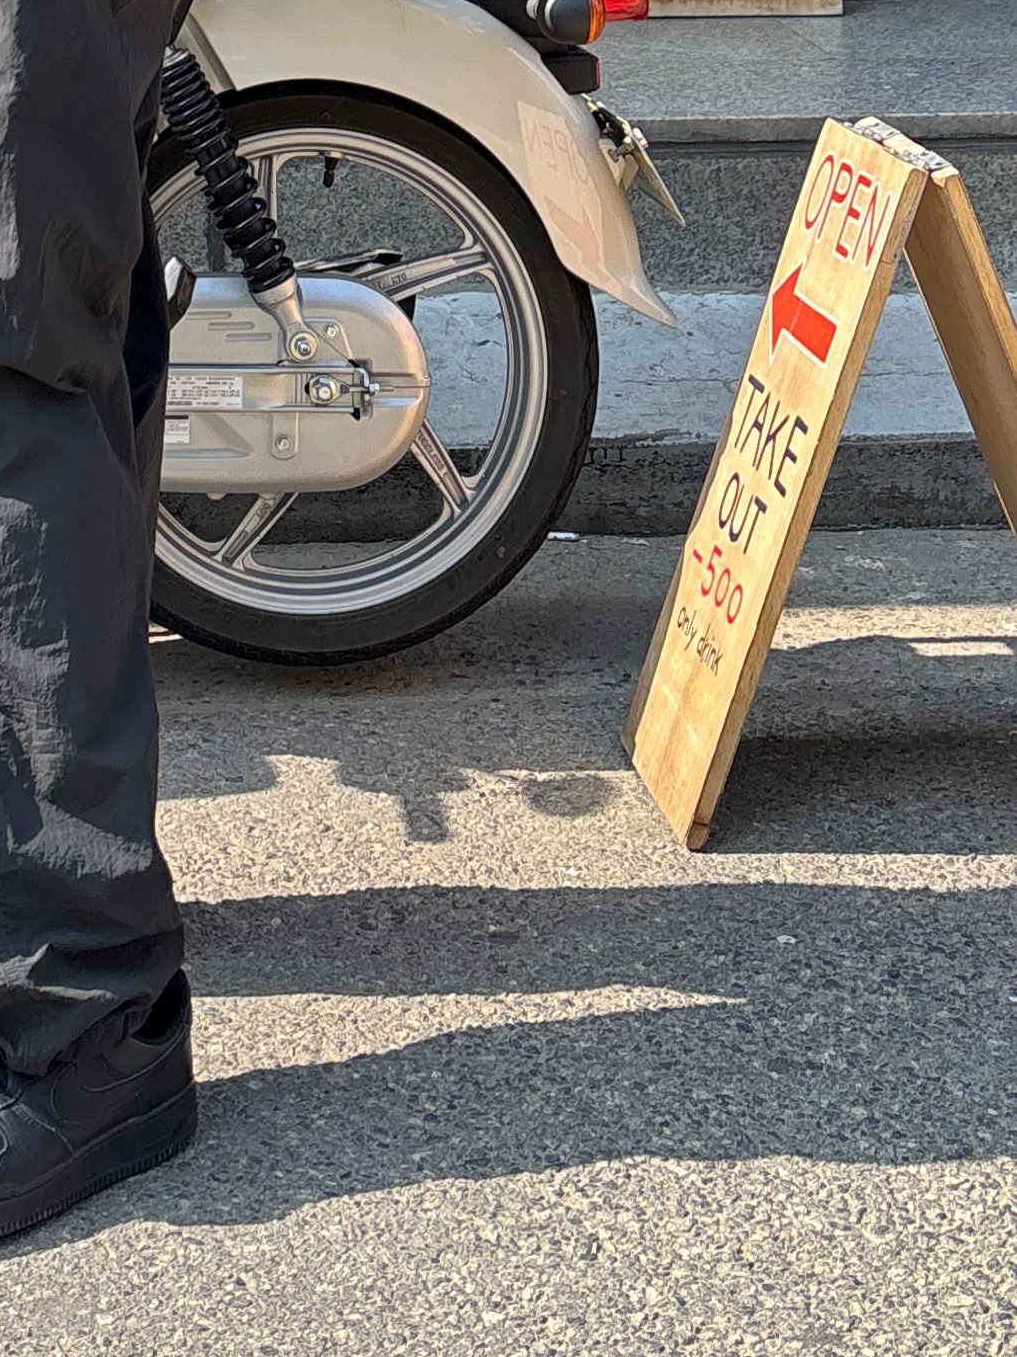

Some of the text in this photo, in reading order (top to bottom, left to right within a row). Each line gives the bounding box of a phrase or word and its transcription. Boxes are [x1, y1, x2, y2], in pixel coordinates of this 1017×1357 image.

[804, 153, 892, 268] OPEN
[734, 373, 809, 498] TAKE
[718, 472, 768, 555] OUT
[692, 544, 743, 625] -500
[696, 622, 724, 677] drink
